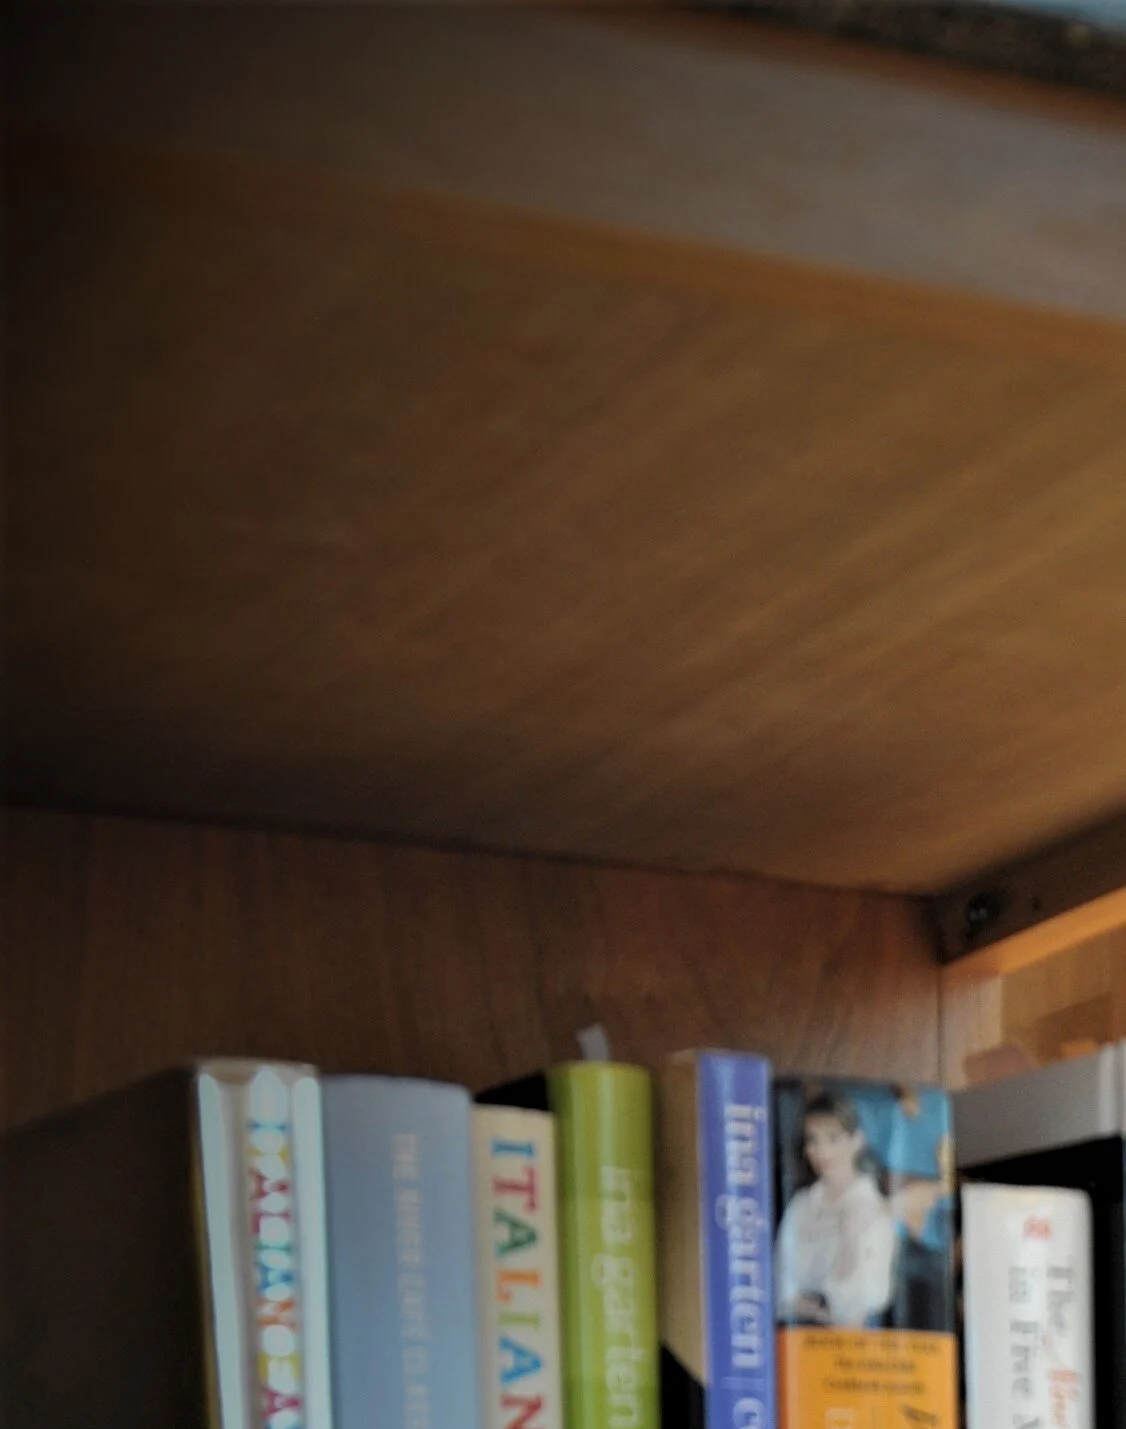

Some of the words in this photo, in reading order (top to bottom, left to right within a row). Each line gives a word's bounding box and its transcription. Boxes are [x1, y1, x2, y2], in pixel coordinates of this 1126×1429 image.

[724, 1104, 769, 1184] ina
[601, 1164, 641, 1244] ina
[716, 1192, 768, 1368] garten
[1008, 1266, 1037, 1304] in
[1045, 1262, 1079, 1330] The
[592, 1254, 647, 1428] garten
[1009, 1320, 1041, 1398] Five
